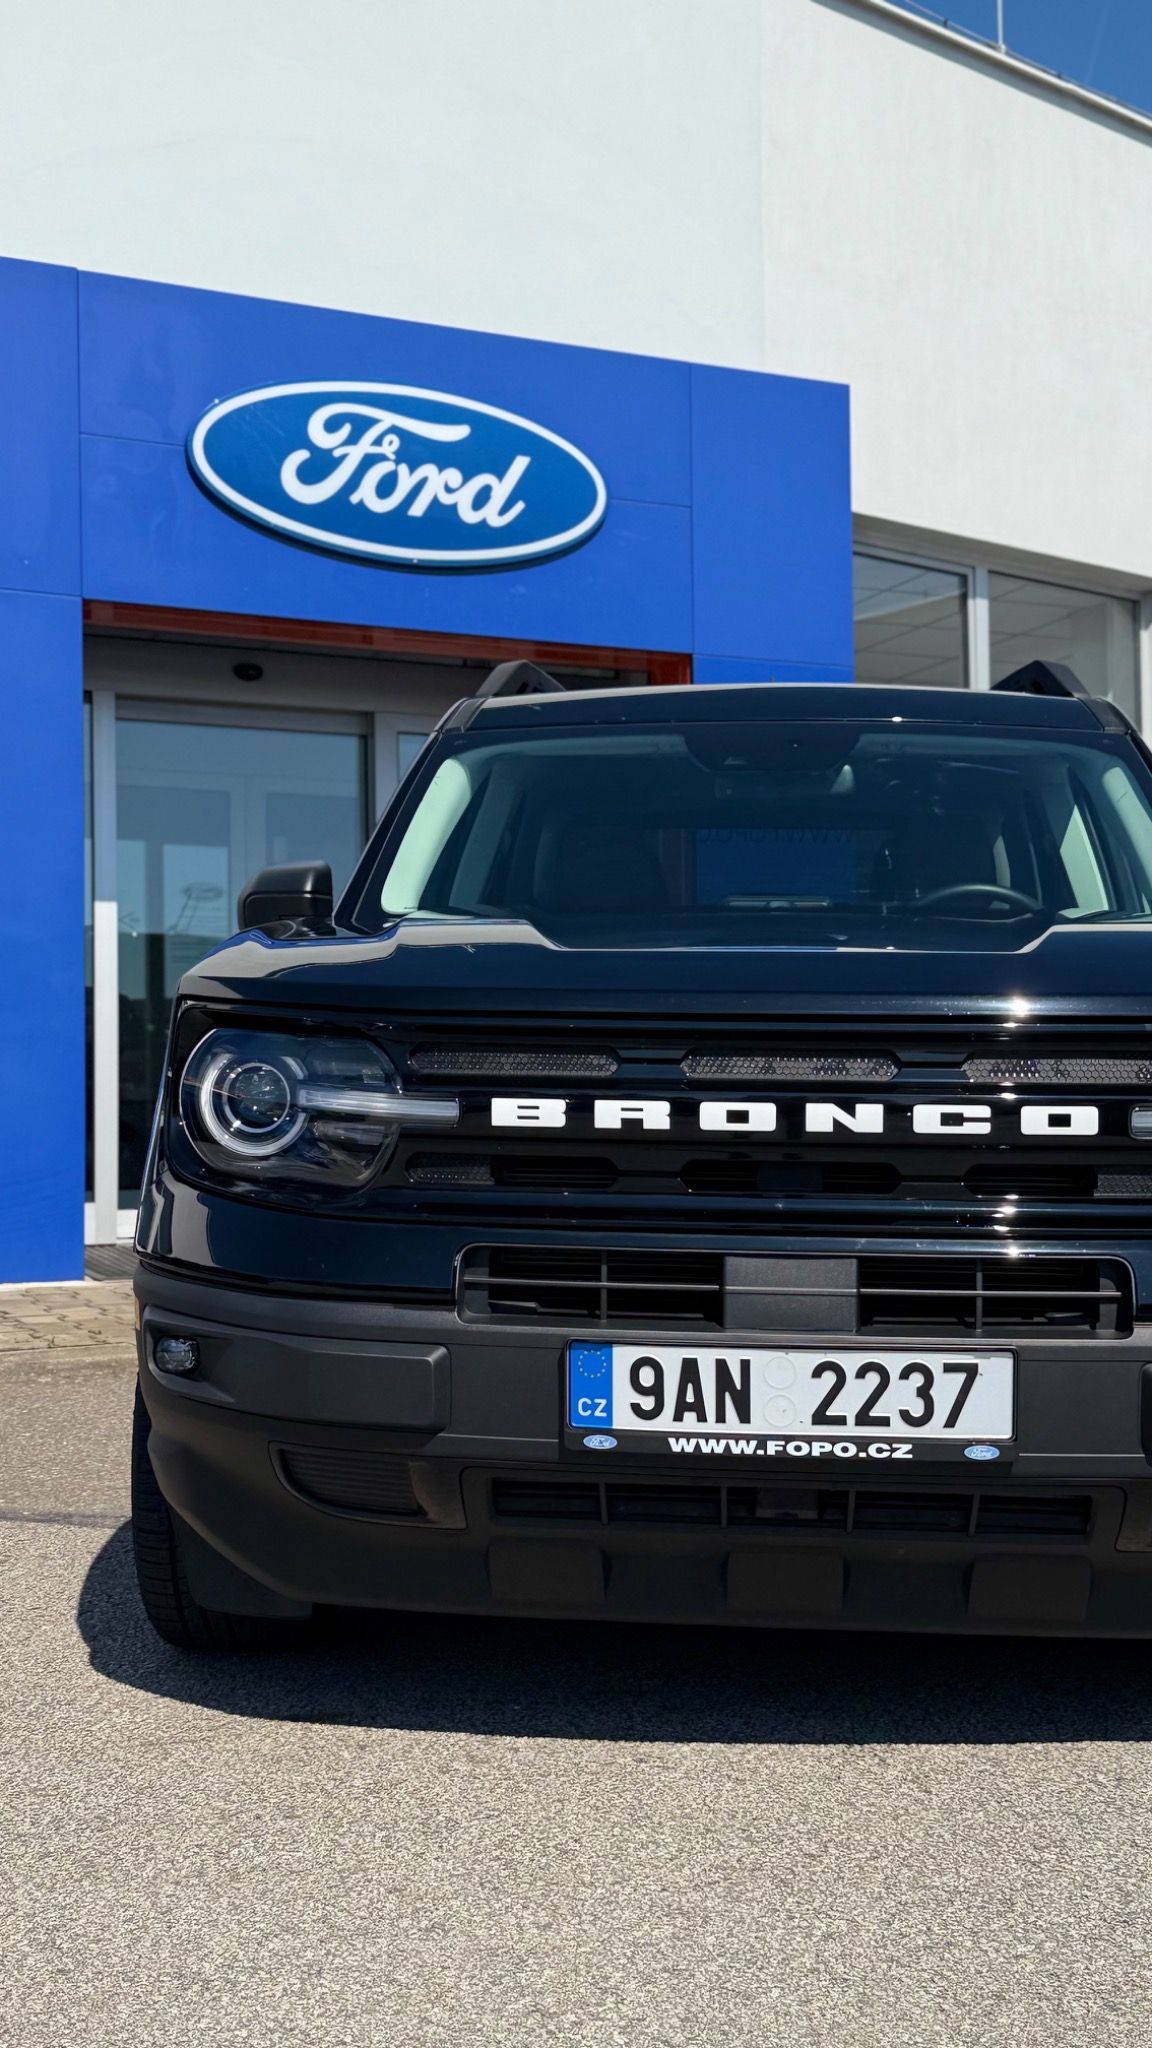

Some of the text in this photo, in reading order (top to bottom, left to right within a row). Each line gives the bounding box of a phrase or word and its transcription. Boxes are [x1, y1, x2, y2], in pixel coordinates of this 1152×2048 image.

[281, 402, 531, 528] Ford
[491, 1097, 1099, 1136] BRONCO
[578, 1397, 608, 1417] CZ
[629, 1356, 980, 1429] 9AN 2237
[668, 1437, 914, 1460] WWW.FOPO.CZ
